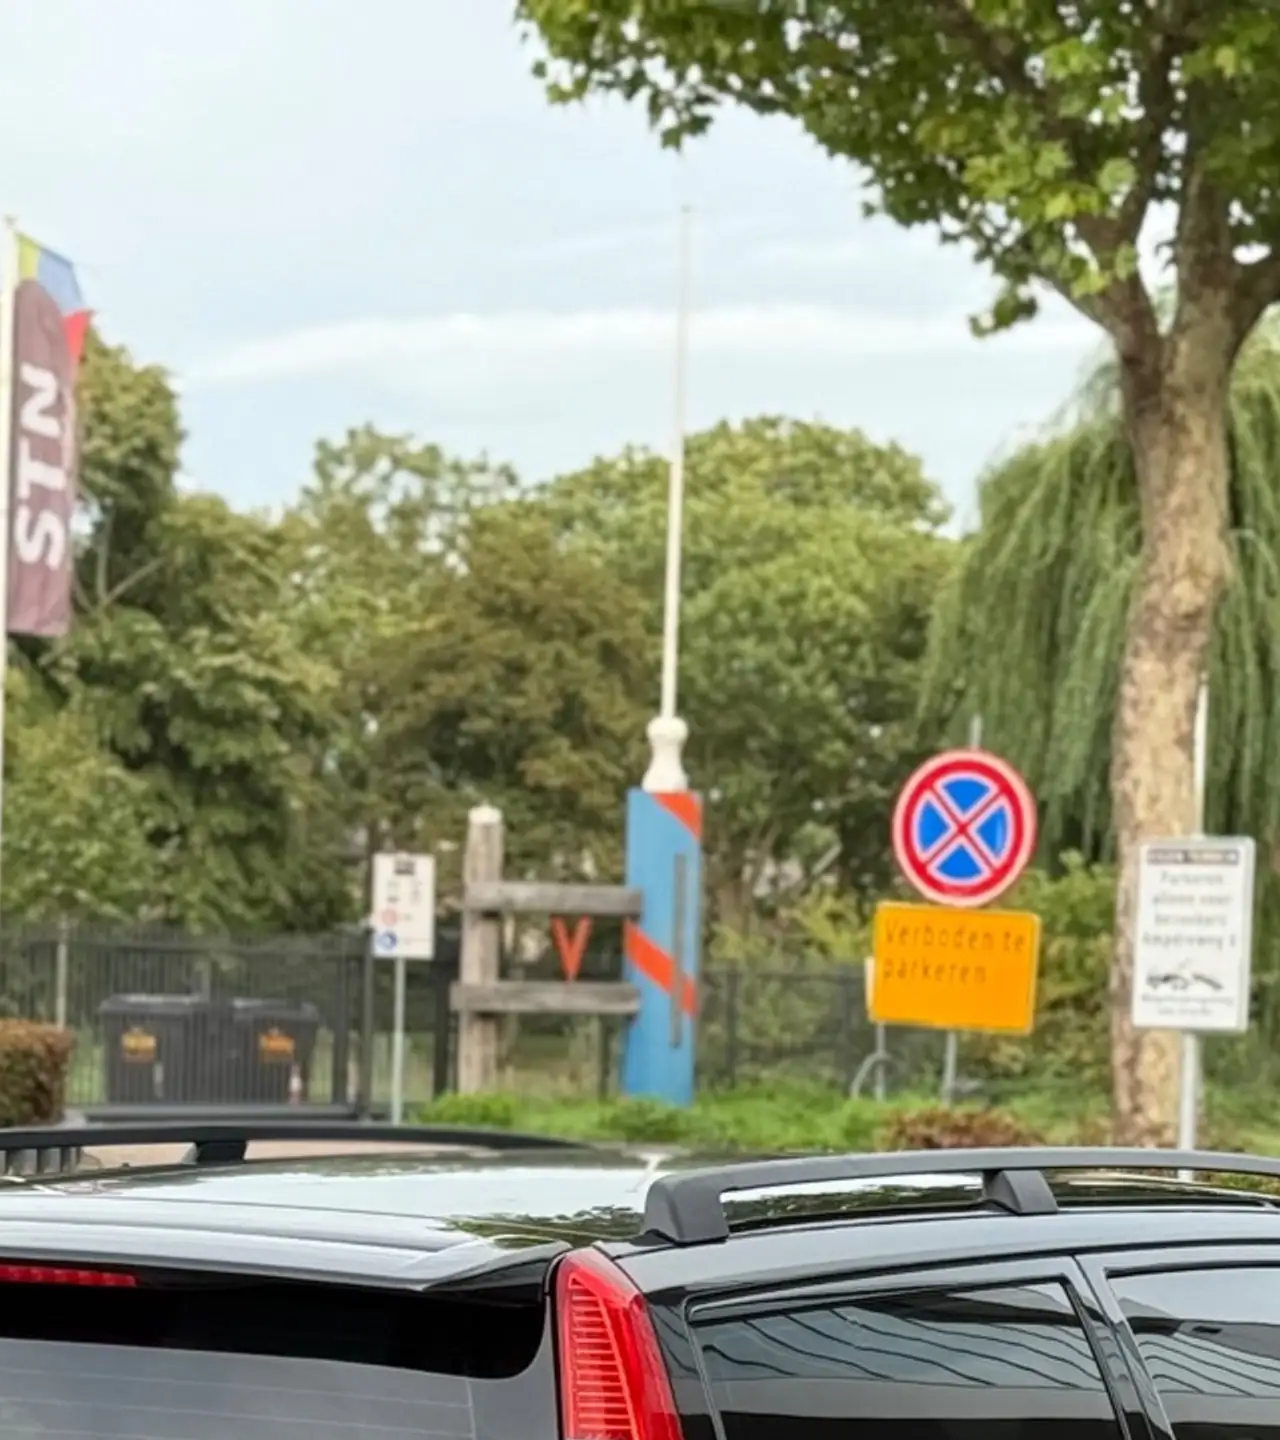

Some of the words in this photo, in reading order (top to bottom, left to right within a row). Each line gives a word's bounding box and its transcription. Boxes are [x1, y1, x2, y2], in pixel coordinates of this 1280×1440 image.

[15, 362, 67, 571] STN
[885, 919, 995, 952] Verboden
[1003, 929, 1027, 954] te
[883, 957, 989, 987] parkeren
